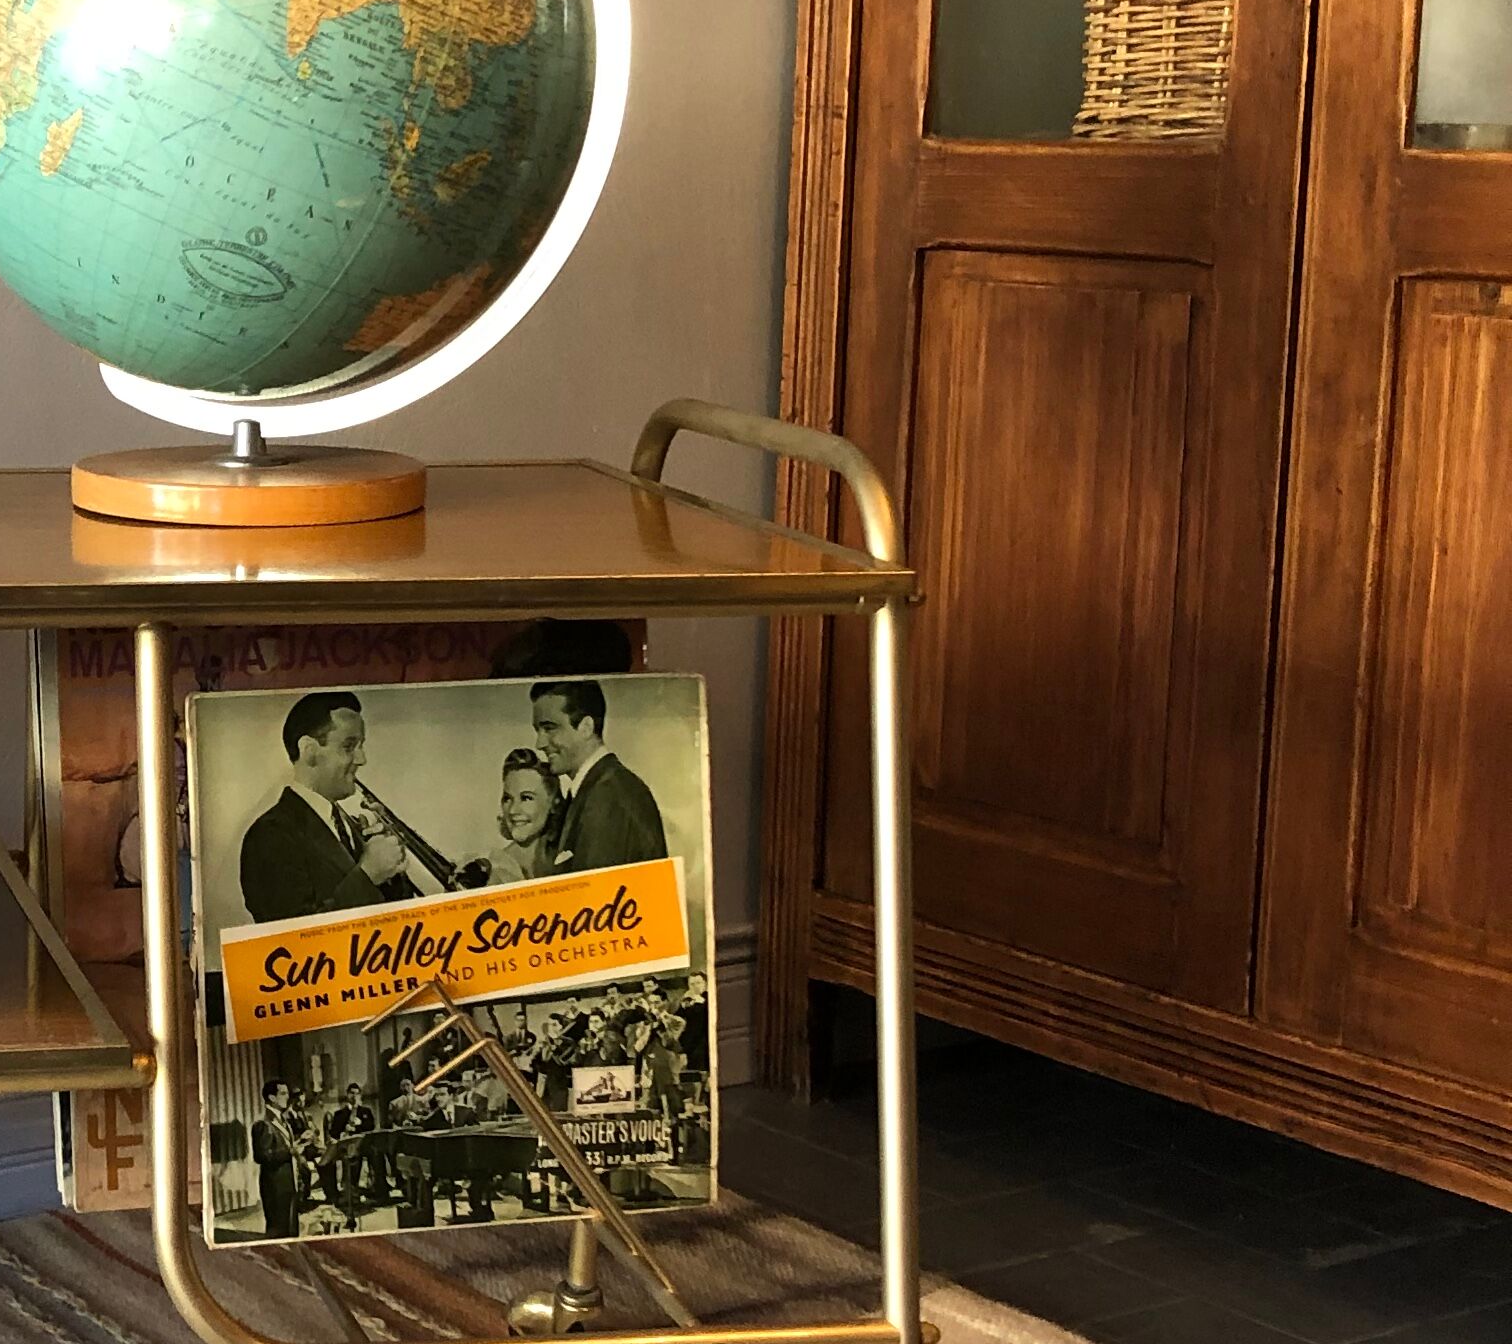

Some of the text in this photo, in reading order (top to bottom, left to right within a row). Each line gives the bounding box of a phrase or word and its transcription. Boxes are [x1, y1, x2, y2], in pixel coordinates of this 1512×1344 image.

[68, 624, 489, 679] MAALIA JACKSON
[259, 885, 643, 993] Sun Valley Serenade
[254, 935, 648, 1019] GLENN MILLER AND HIS ORCHESTRA
[562, 1120, 628, 1145] MASTER'S
[630, 1120, 671, 1142] VOICE
